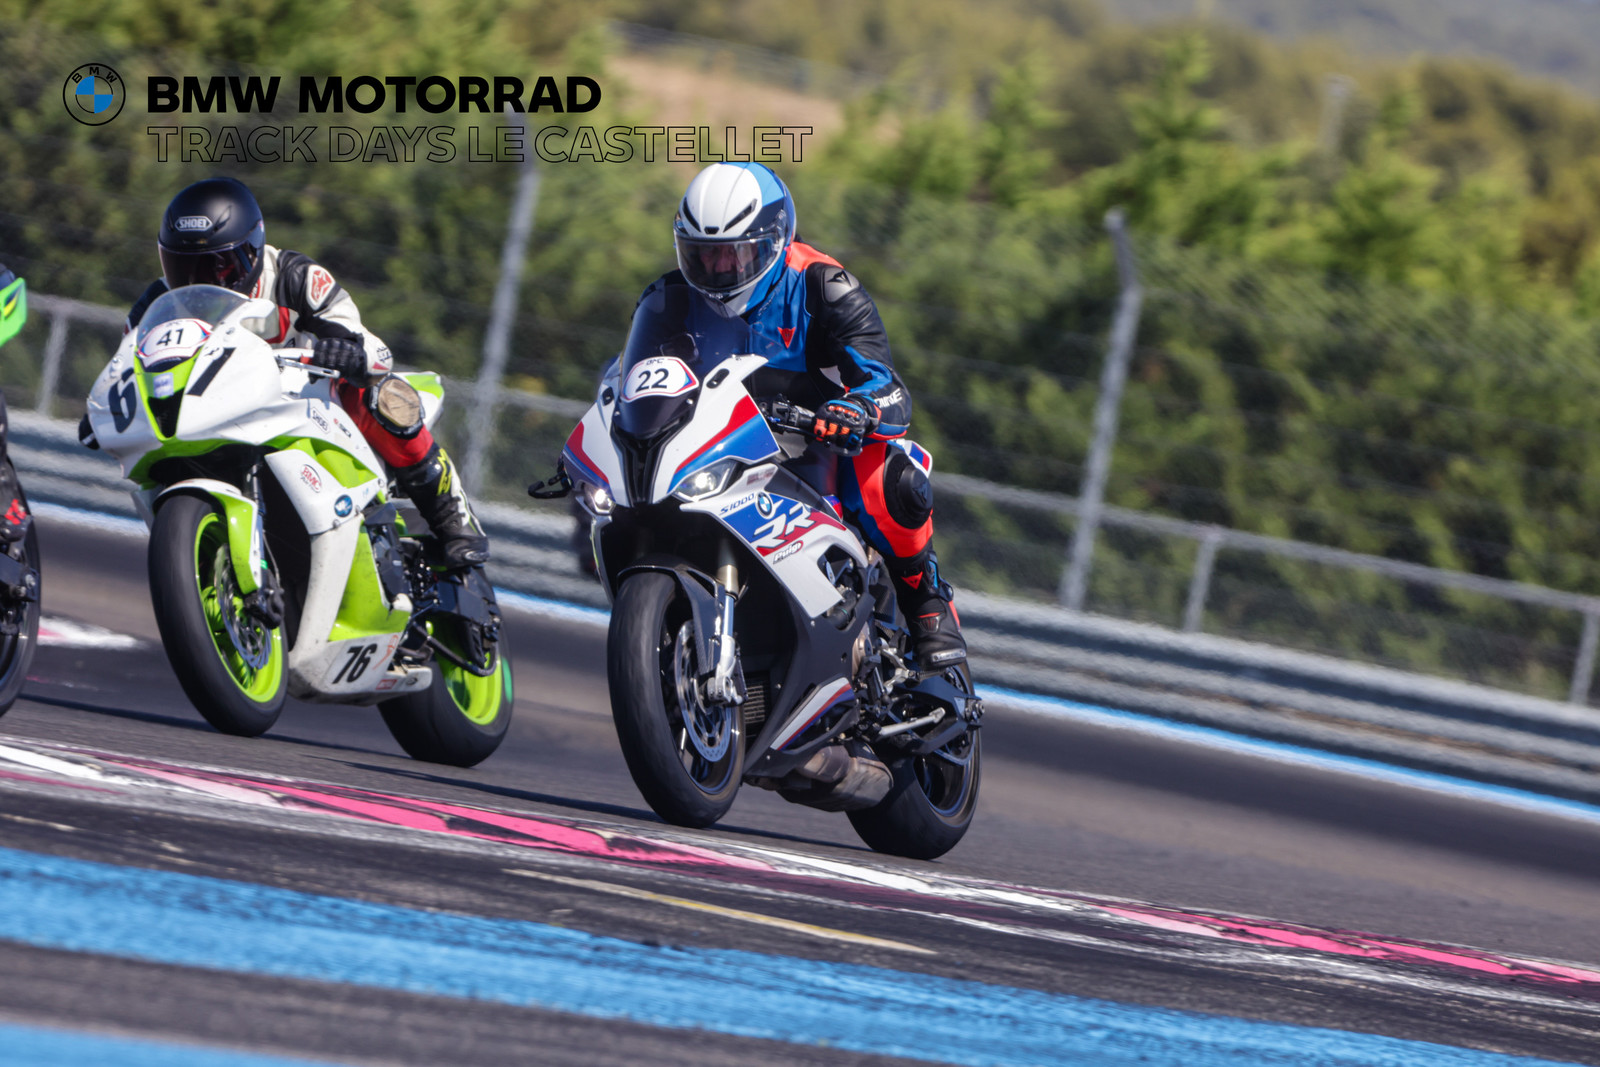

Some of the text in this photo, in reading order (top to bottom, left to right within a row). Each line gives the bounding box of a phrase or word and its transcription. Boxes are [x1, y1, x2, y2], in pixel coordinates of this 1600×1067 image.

[179, 217, 207, 230] SHOEI
[156, 327, 184, 346] 41
[635, 367, 669, 393] 22
[108, 367, 138, 434] 6
[720, 492, 755, 514] S1000
[752, 501, 817, 549] RR
[332, 643, 378, 684] 76
